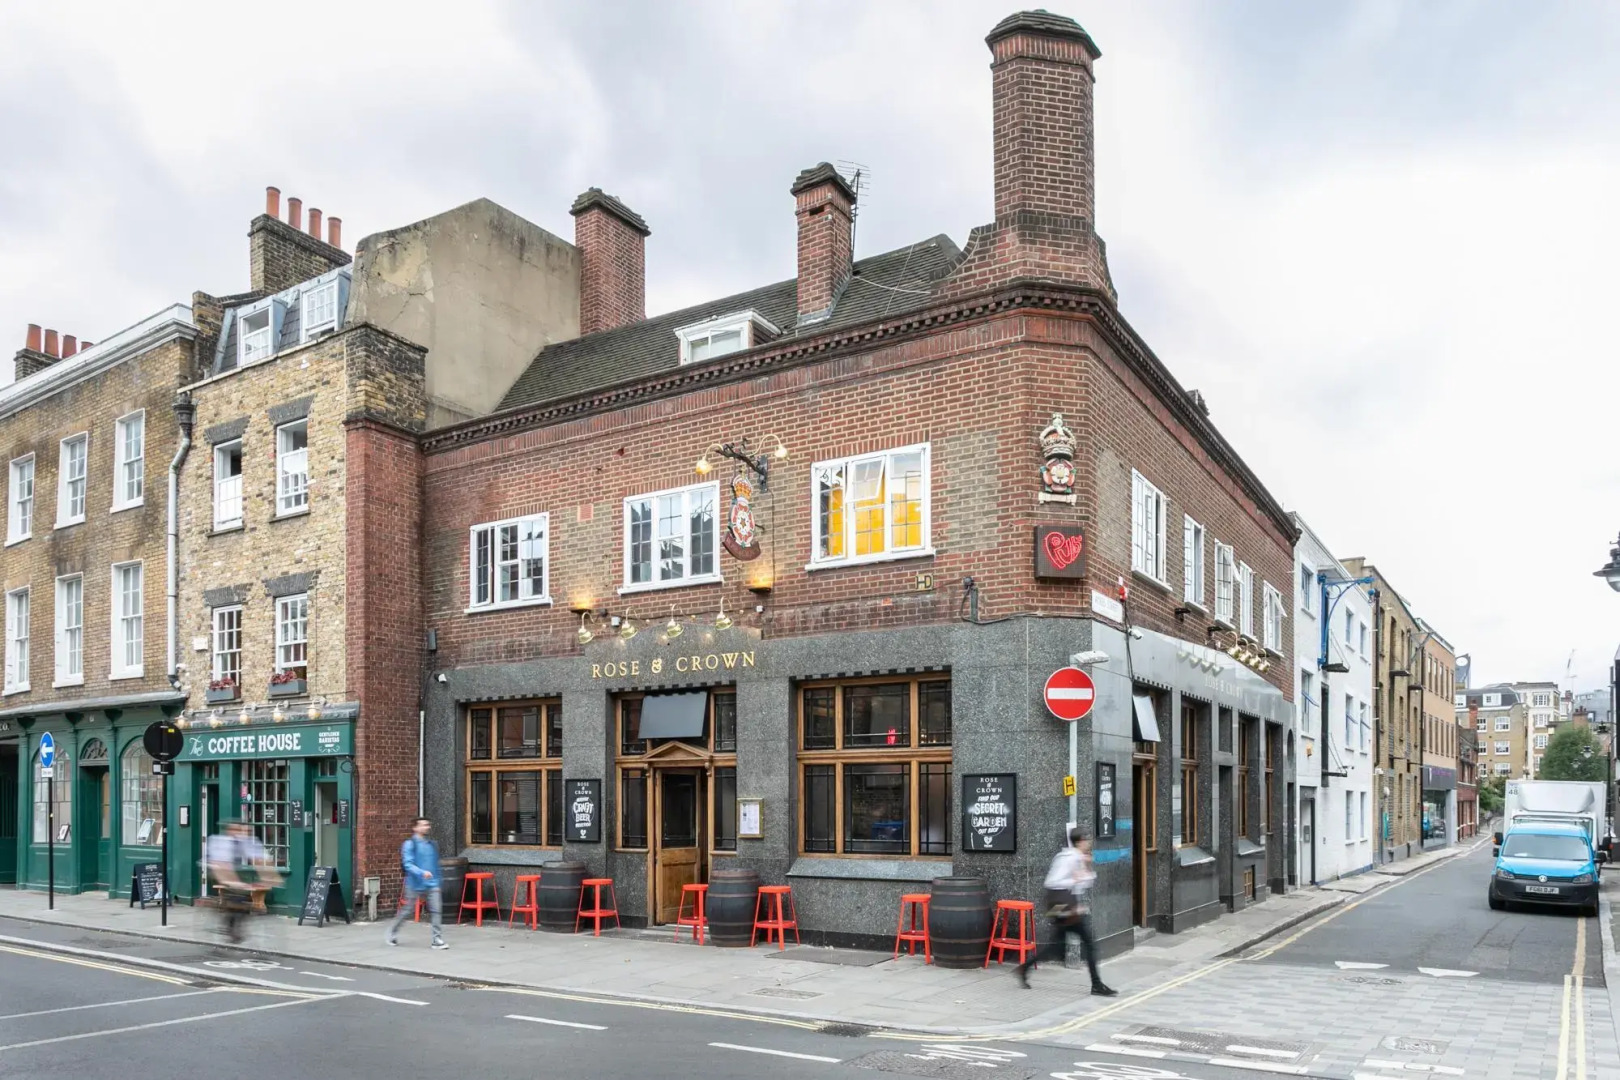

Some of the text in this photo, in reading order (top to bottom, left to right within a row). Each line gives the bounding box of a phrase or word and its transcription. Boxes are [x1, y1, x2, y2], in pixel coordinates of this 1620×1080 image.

[592, 651, 755, 678] ROSE & CROWN
[208, 735, 255, 754] COFFEE
[258, 732, 302, 752] HOUSE
[1065, 777, 1075, 793] H
[572, 801, 594, 814] CRAFT
[974, 802, 1005, 815] SECRET
[575, 813, 591, 823] BEER
[971, 816, 1007, 828] GARDEN
